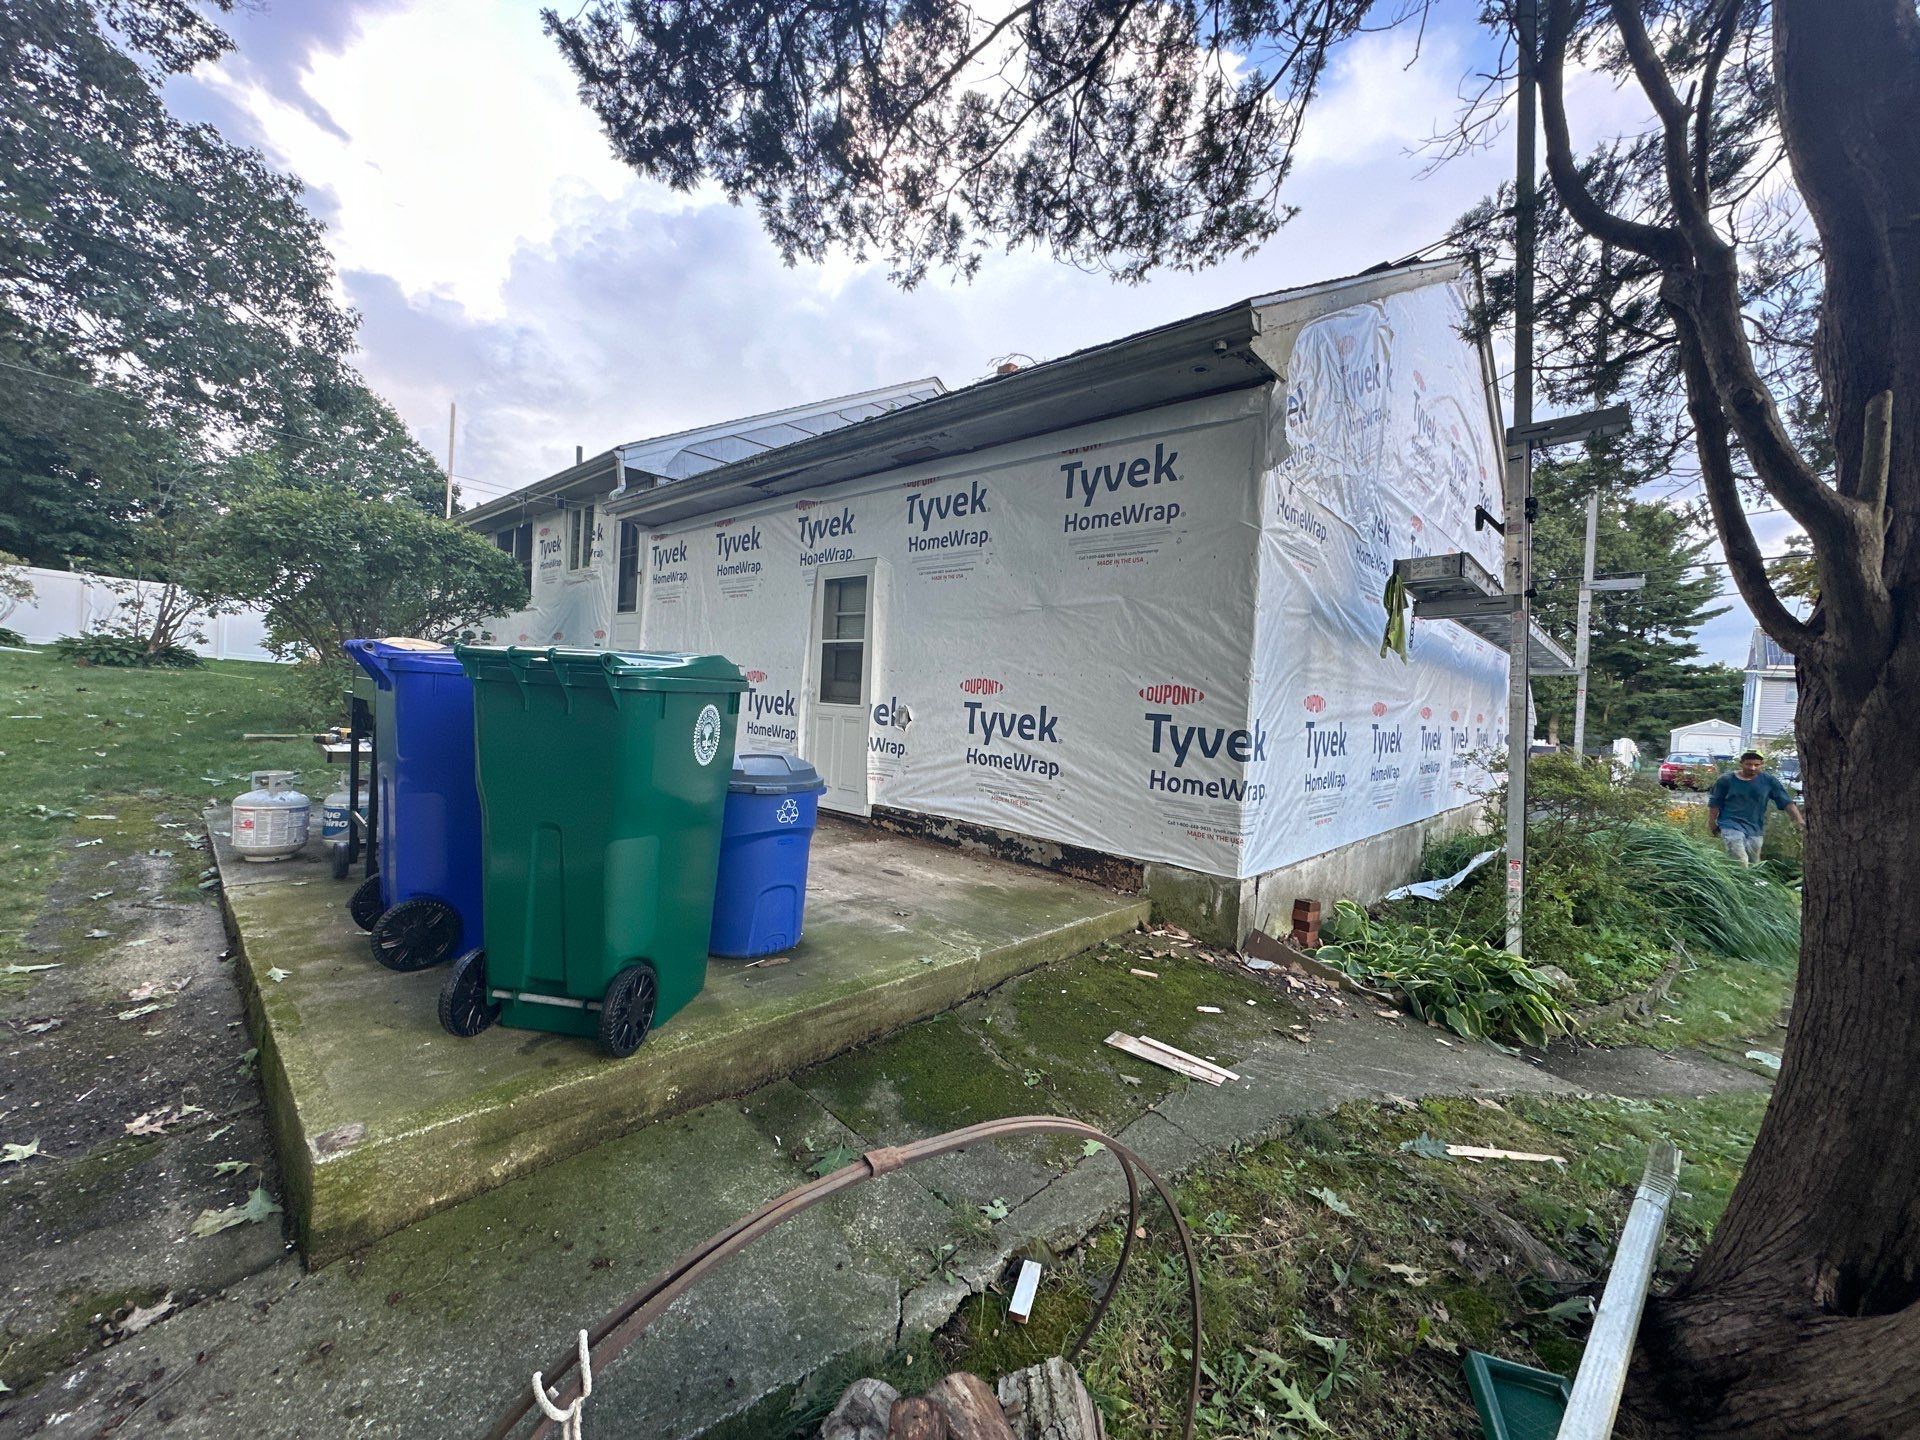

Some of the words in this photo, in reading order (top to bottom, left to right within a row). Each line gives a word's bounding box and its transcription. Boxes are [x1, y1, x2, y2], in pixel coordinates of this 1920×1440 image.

[1060, 443, 1178, 508] Tyvek
[906, 481, 987, 531] Tyvek
[1064, 502, 1180, 533] HomeWrap
[1276, 493, 1327, 545] HomeWrap
[716, 525, 761, 562] Tyvek
[798, 507, 855, 549] Tyvek
[908, 529, 989, 553] HomeWrap
[540, 535, 562, 560] Tyvek
[652, 540, 688, 572] Tyvek
[652, 570, 688, 585] HomeWrap
[717, 560, 762, 577] HomeWrap
[964, 678, 999, 695] DUPONT
[1146, 684, 1198, 706] DUPONT
[748, 688, 796, 720] Tyvek
[746, 721, 797, 743] HomeWrap
[964, 701, 1058, 746] Tyvek
[1145, 712, 1267, 768] Tyvek
[1305, 721, 1347, 769] Tyvek
[1371, 723, 1402, 763] Tyvek
[1421, 725, 1442, 758] Tyvek
[966, 747, 1060, 780] HomeWrap
[1370, 764, 1400, 782] HomeWrap
[1149, 769, 1267, 806] HomeWrap
[1304, 770, 1346, 792] HomeWrap
[1186, 830, 1206, 839] MADE
[1216, 835, 1230, 843] THE
[1230, 837, 1244, 845] USA
